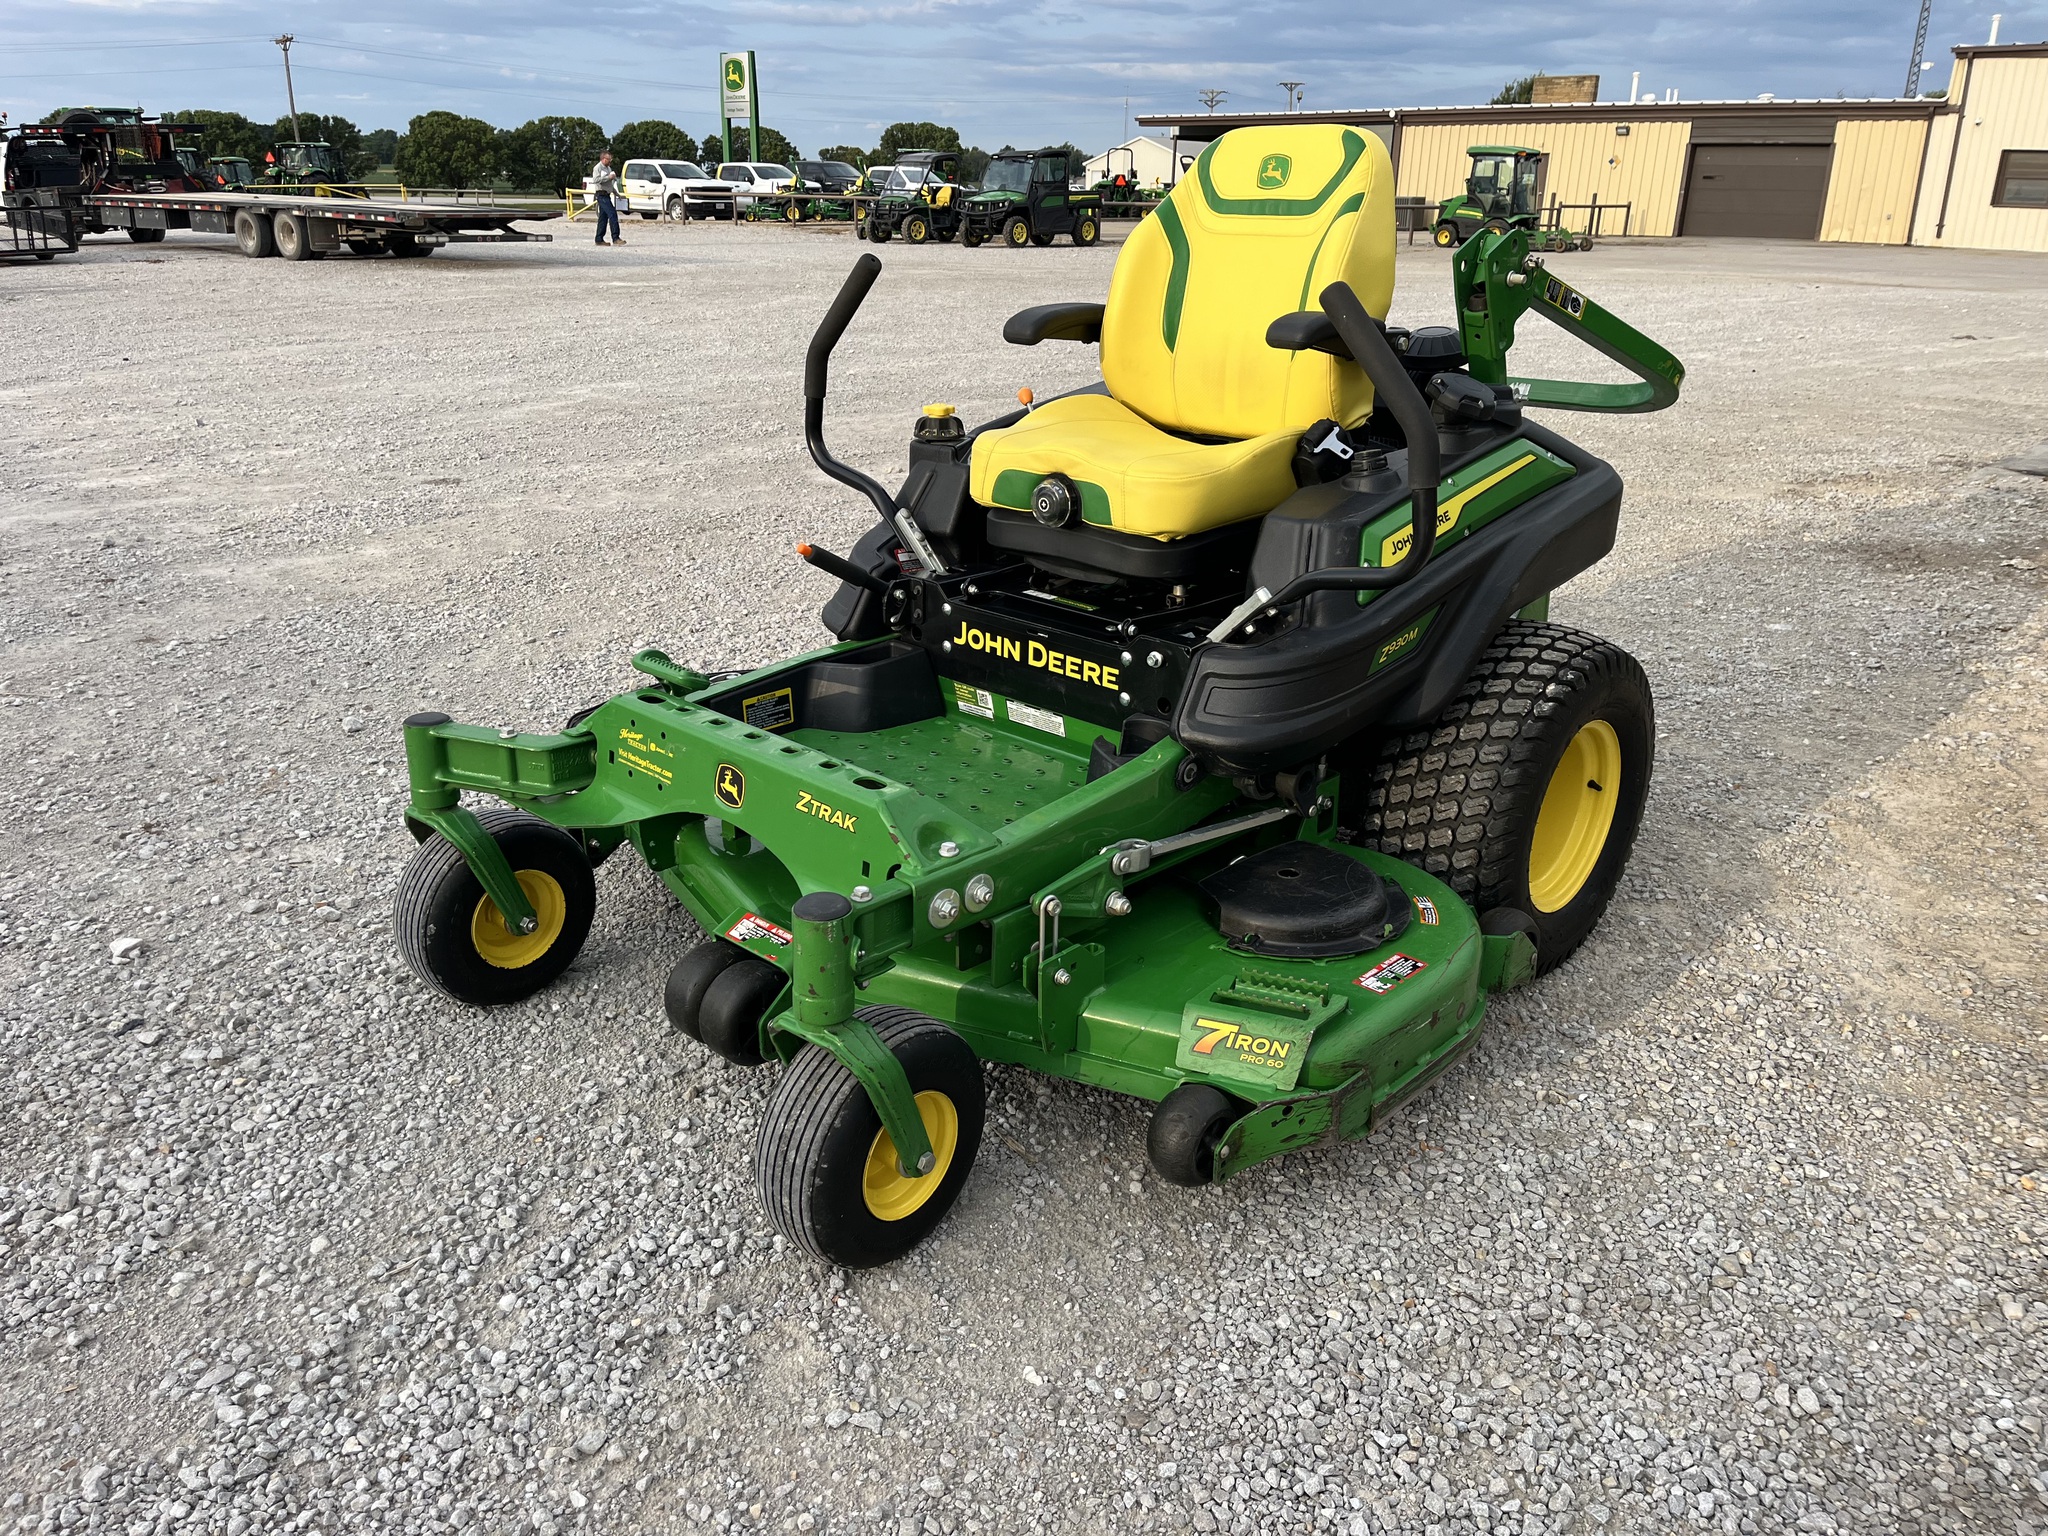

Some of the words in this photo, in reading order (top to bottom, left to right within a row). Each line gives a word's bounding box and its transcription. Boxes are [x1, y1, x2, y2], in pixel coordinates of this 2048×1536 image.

[953, 621, 1020, 662] JOHN
[1028, 640, 1120, 691] DEERE
[1379, 627, 1419, 664] Z930M
[795, 790, 859, 834] ZTRAK
[1239, 1053, 1265, 1065] PRO
[1266, 1059, 1284, 1069] 60
